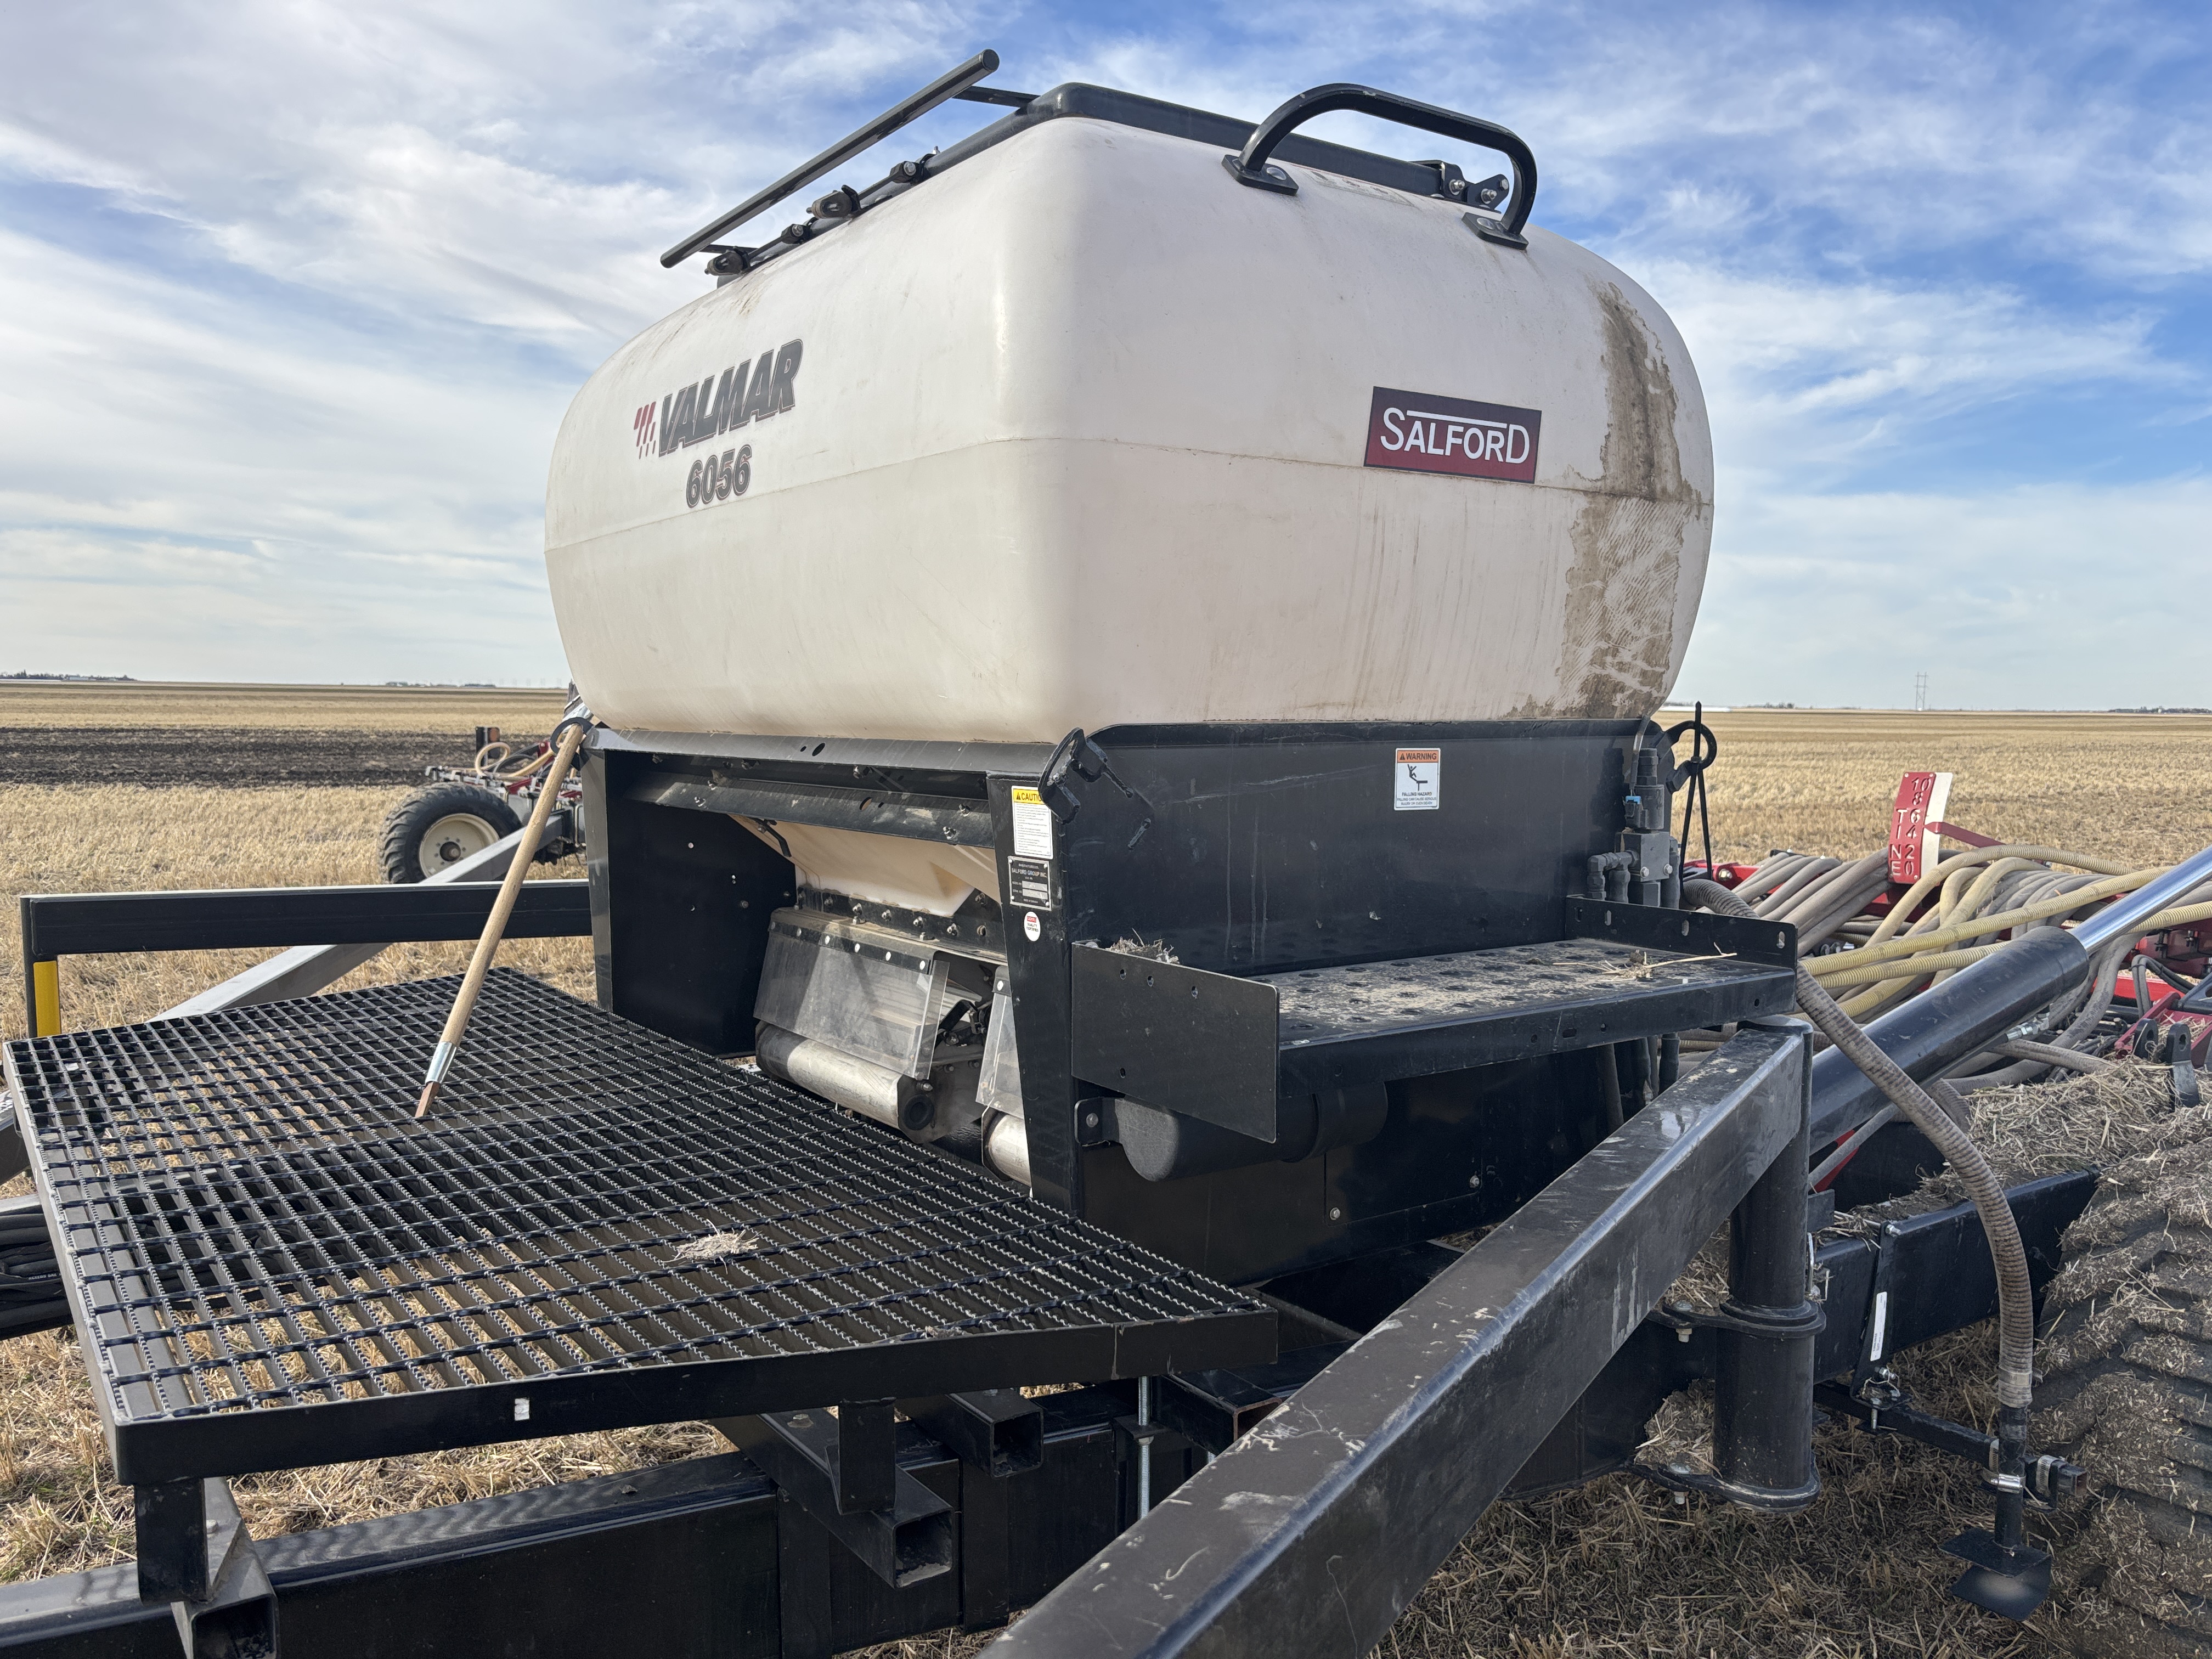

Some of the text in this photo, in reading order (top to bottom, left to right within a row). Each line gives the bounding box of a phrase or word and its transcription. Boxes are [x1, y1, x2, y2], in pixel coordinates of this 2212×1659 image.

[659, 338, 803, 458] VALMAR
[1380, 408, 1530, 464] SALFORD
[686, 444, 752, 509] 6056
[1911, 777, 1931, 791] 10
[1021, 793, 1043, 802] CAUTIO
[1912, 791, 1923, 805] 8
[1910, 809, 1921, 823] 6
[1906, 825, 1917, 839] 4
[1905, 844, 1915, 860] 2
